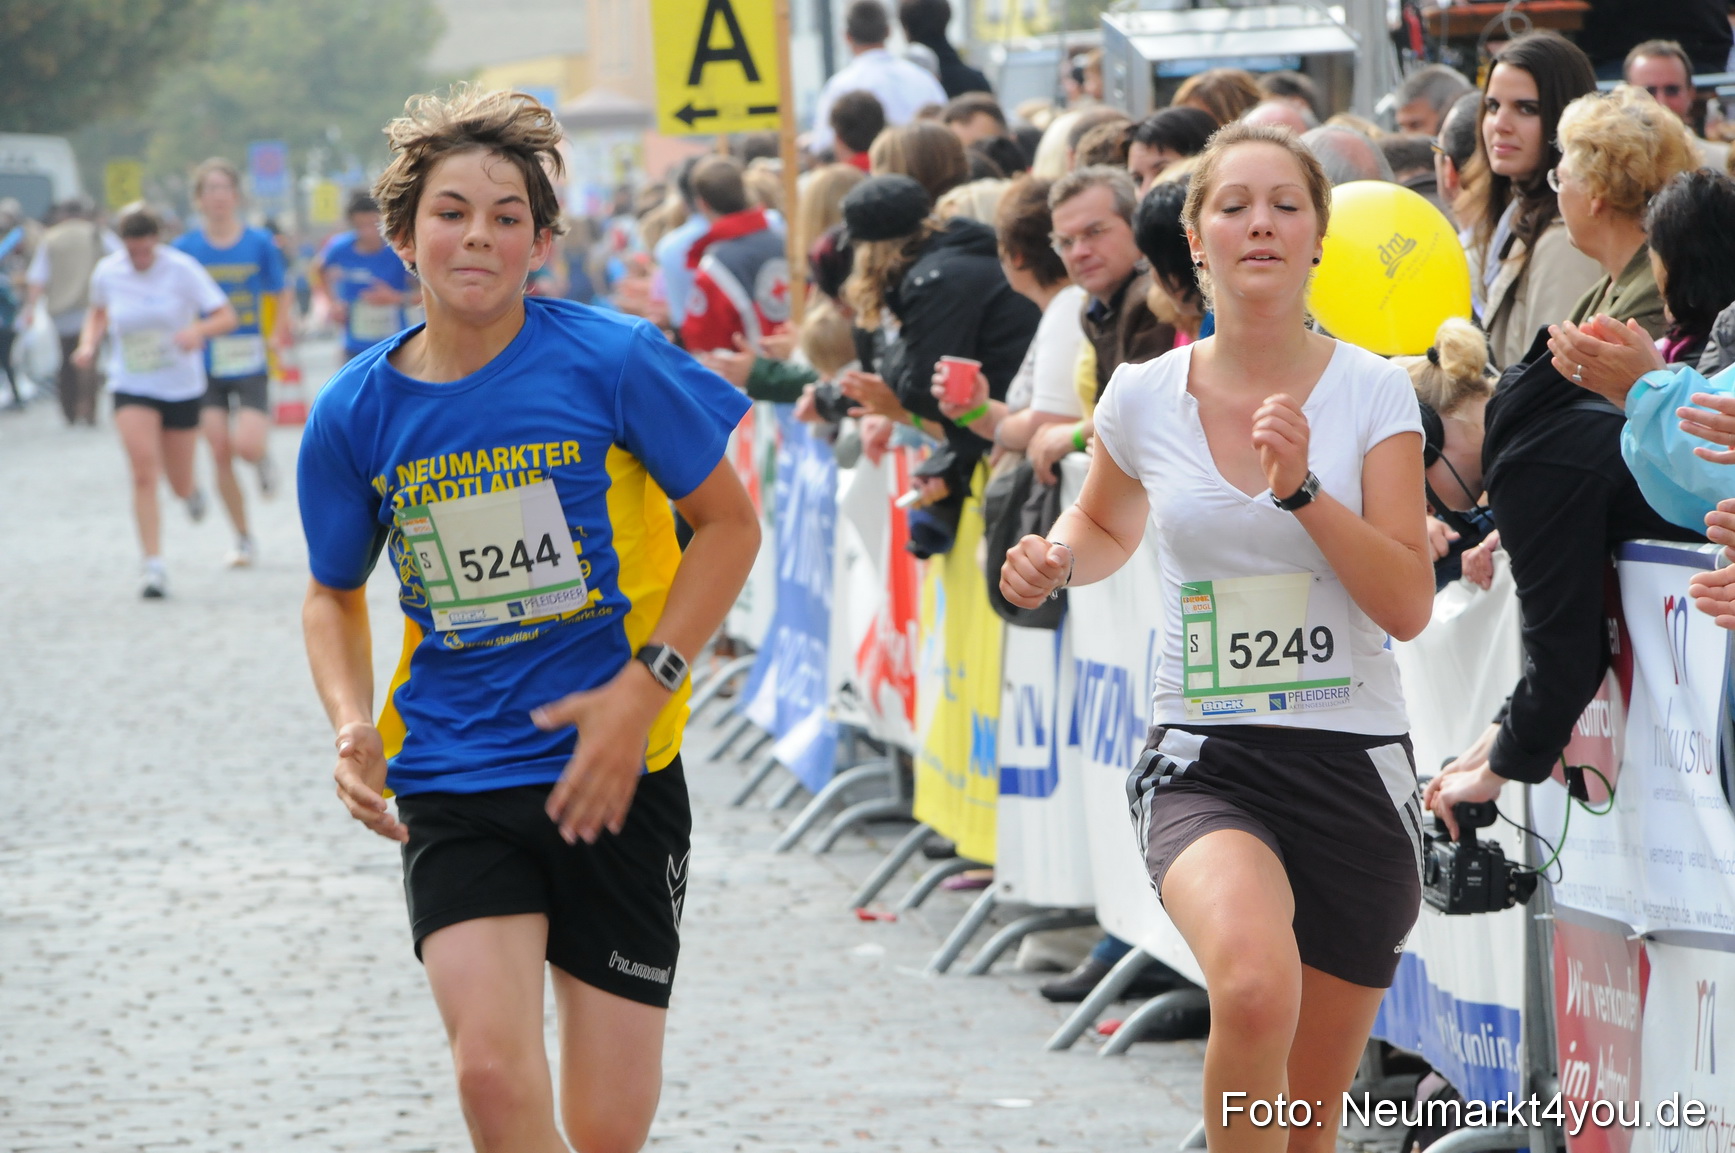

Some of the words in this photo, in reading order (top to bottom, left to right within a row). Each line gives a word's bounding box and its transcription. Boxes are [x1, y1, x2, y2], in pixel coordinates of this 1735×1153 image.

[687, 0, 762, 86] A
[1377, 232, 1408, 267] dm
[396, 440, 582, 488] NEUMARKTER
[420, 552, 432, 569] S
[459, 533, 561, 582] 5244
[1190, 634, 1199, 653] S
[1229, 625, 1335, 669] 5249
[1202, 699, 1244, 712] BOCK
[1288, 687, 1350, 703] PFLEIDERER
[1566, 956, 1590, 1017] Wir
[1562, 1040, 1591, 1099] im
